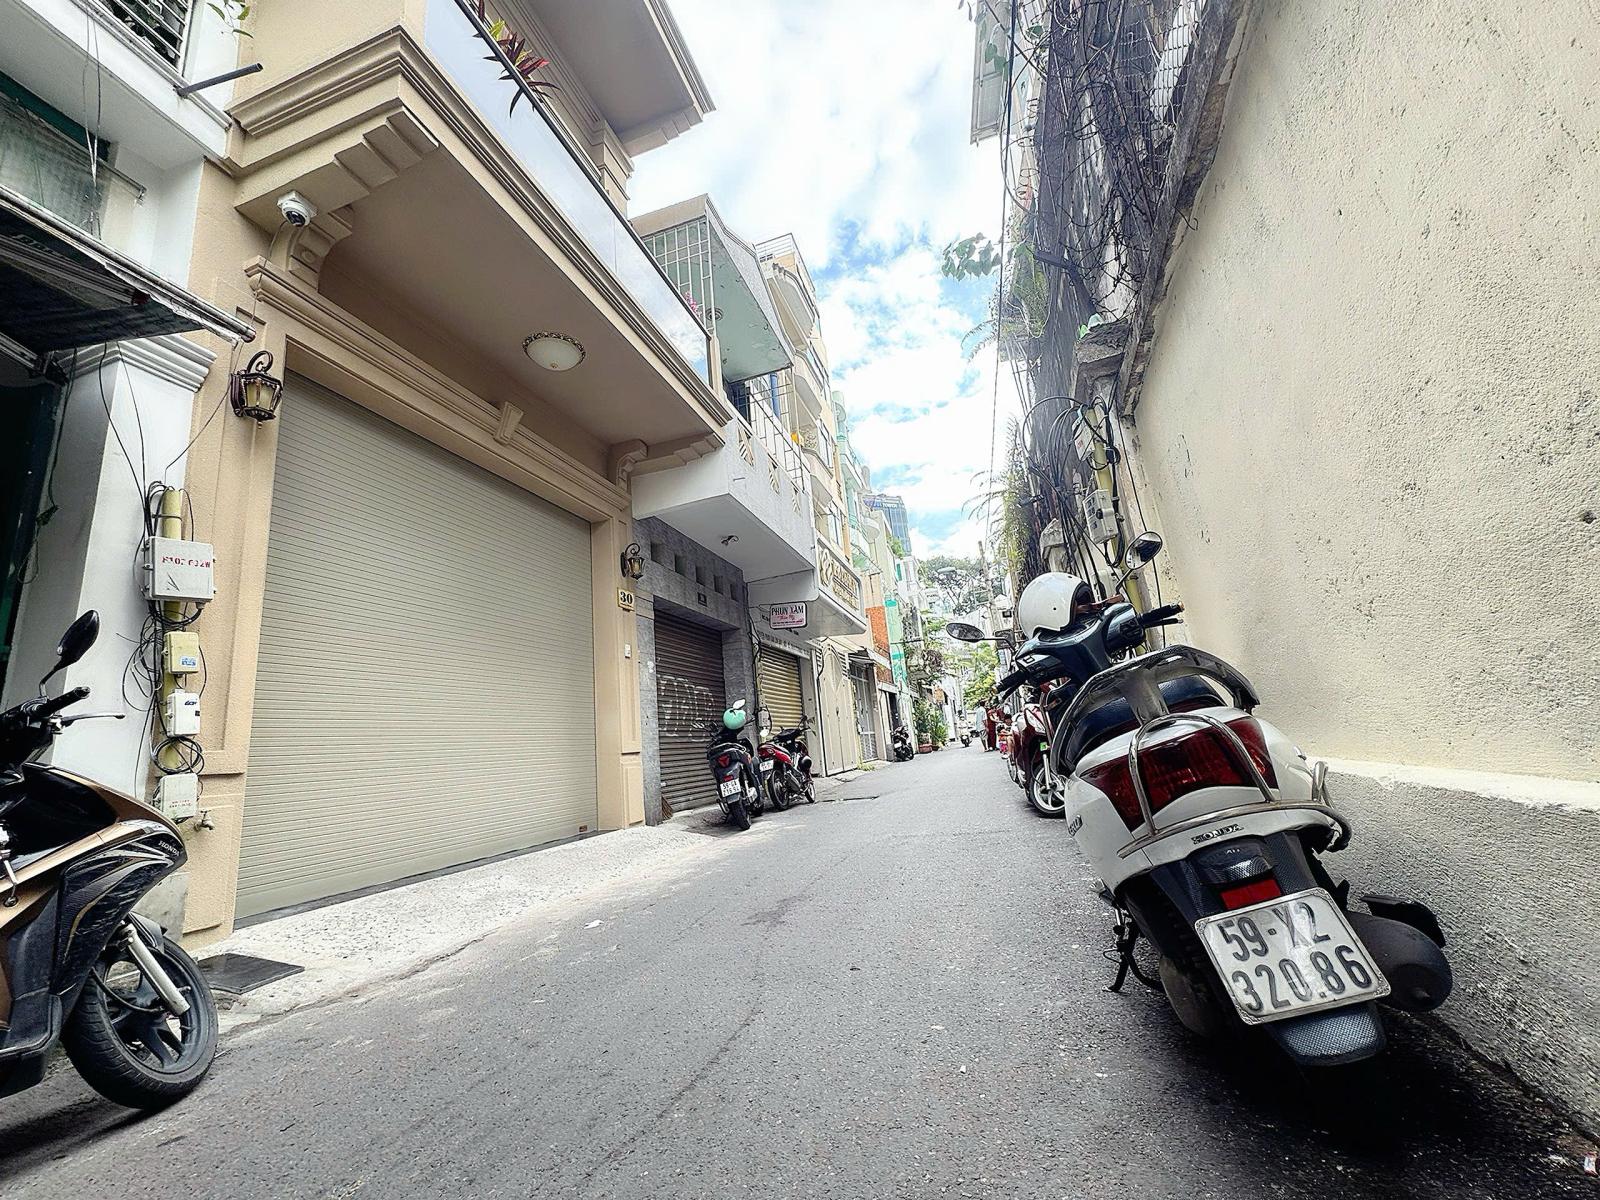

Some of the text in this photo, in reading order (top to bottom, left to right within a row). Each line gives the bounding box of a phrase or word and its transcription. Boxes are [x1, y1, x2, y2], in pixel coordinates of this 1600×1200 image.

[619, 592, 633, 605] 30
[771, 607, 788, 616] PHUN
[1191, 823, 1245, 845] HONDA
[158, 840, 181, 857] HONDA
[1219, 902, 1331, 962] 59-X2
[1231, 944, 1372, 1012] 320.86
